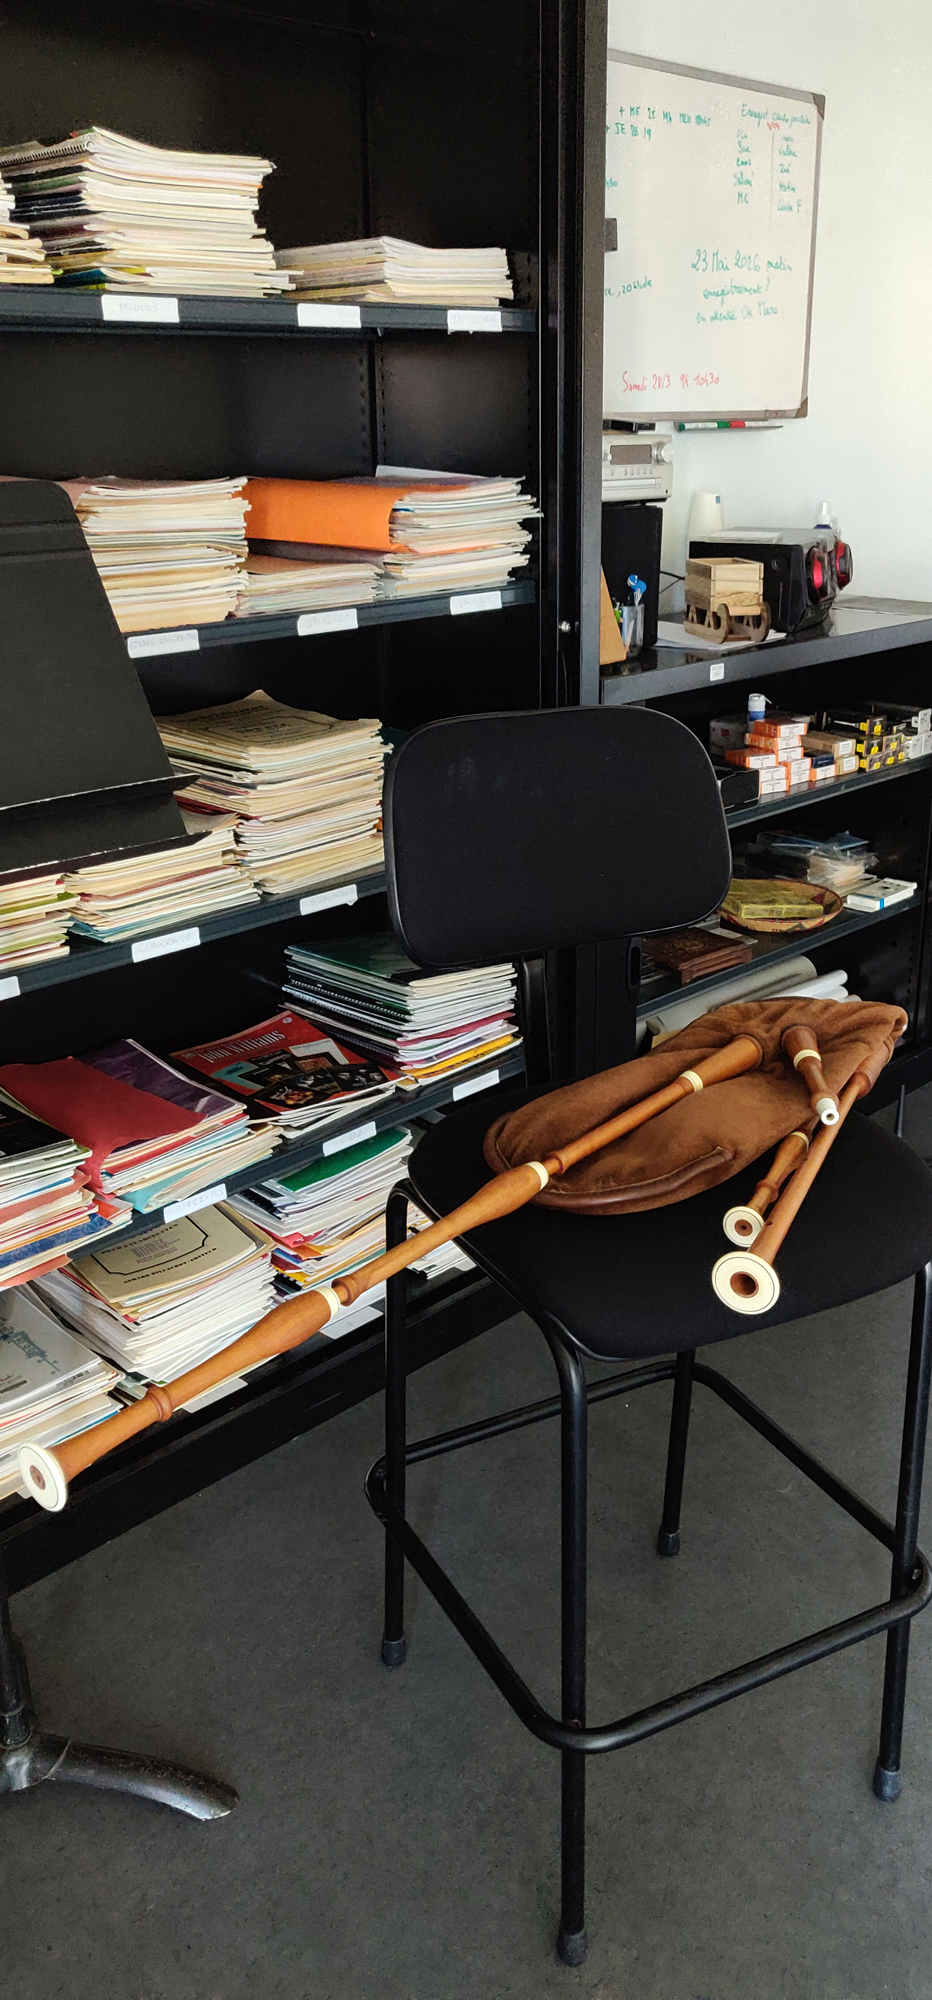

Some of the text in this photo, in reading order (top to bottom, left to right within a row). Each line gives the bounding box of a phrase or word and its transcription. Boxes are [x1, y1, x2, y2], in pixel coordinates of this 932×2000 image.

[691, 248, 708, 272] 23
[711, 249, 730, 272] Mai
[621, 370, 648, 393] Samedi
[226, 1030, 286, 1055] Williams
